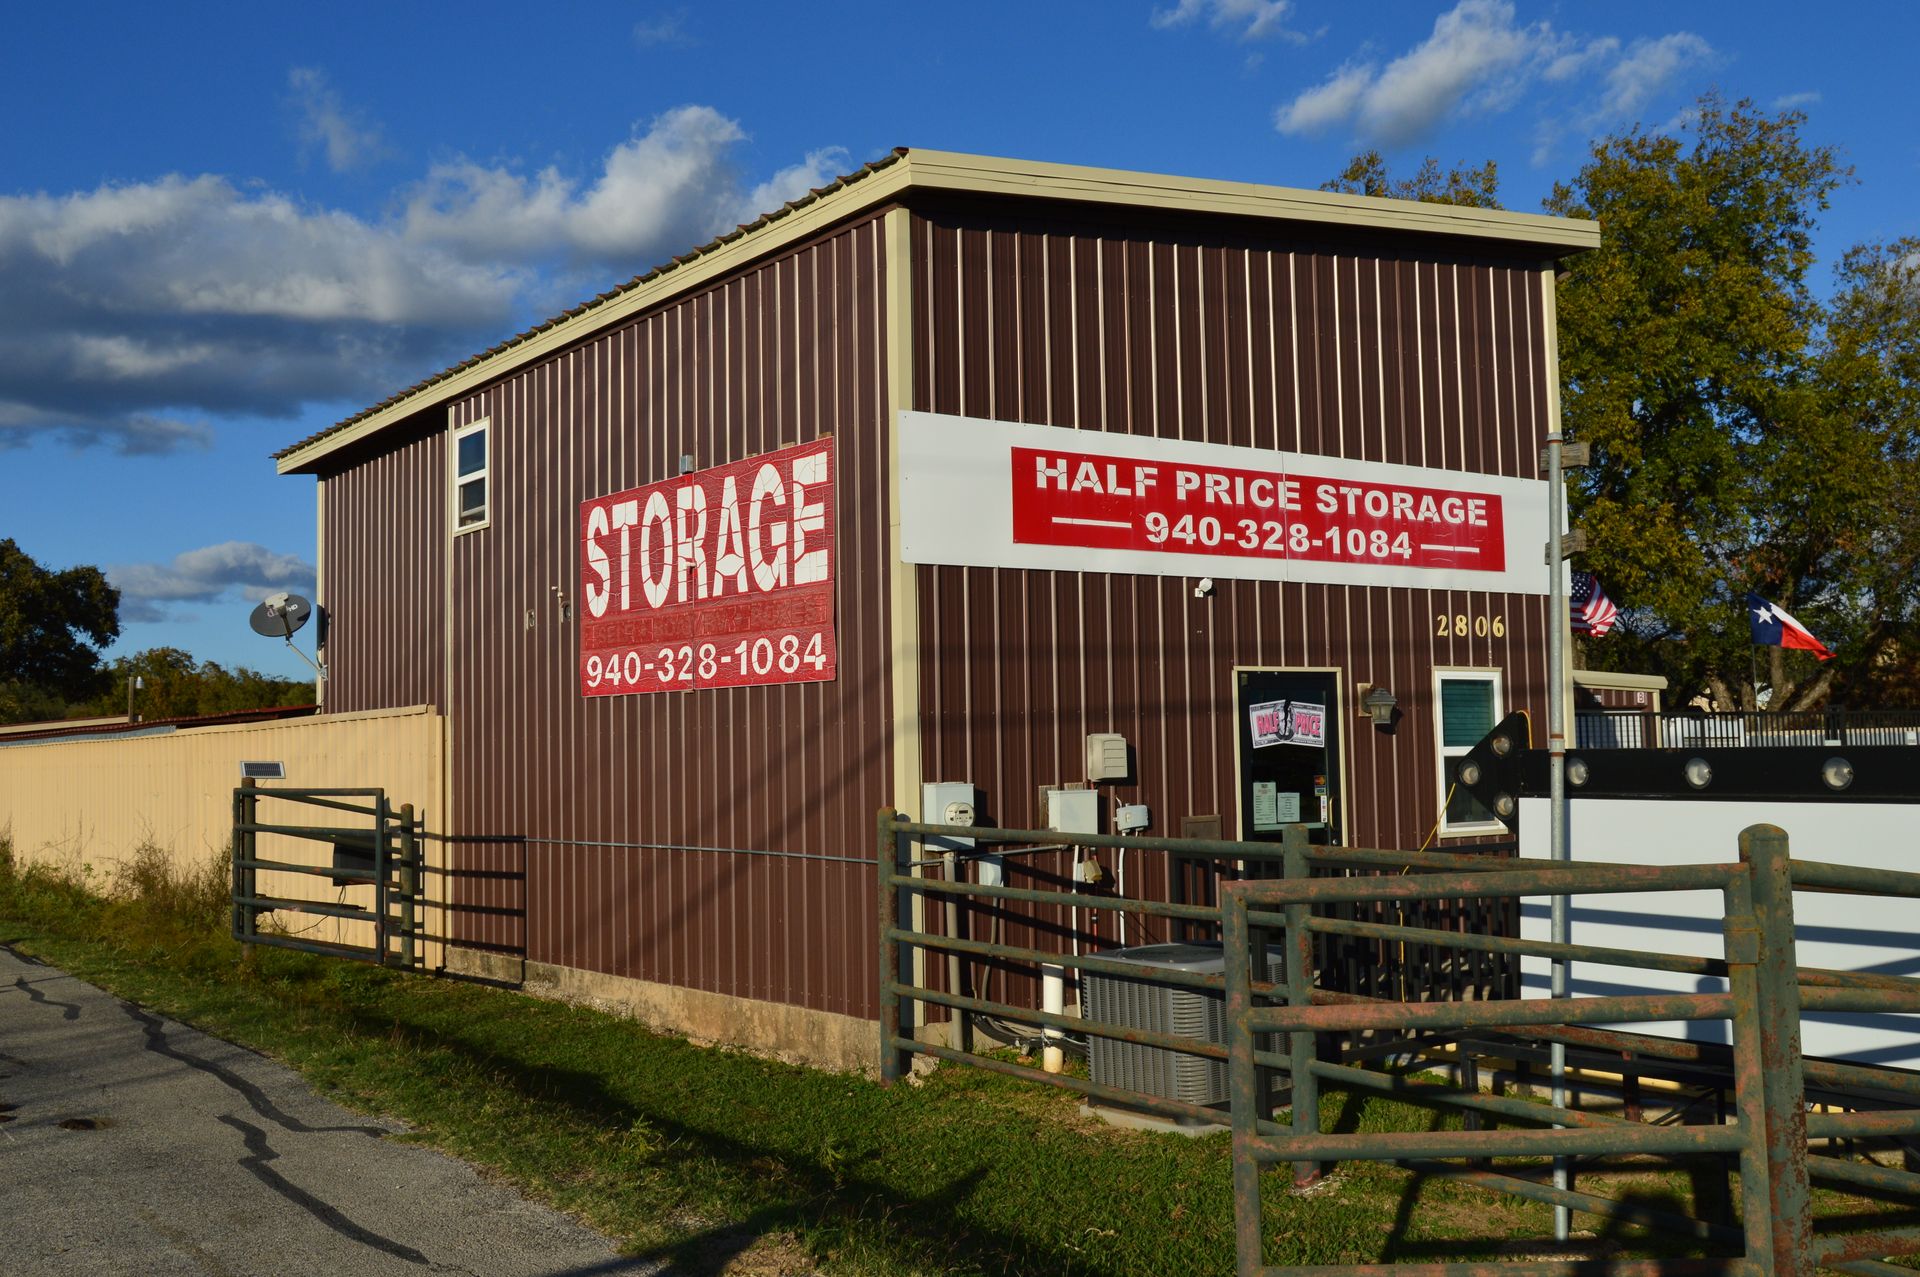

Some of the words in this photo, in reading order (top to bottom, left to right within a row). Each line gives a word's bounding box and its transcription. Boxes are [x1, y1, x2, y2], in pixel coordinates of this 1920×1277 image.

[1036, 457, 1158, 497] HALF
[1176, 470, 1302, 511] PRICE
[1316, 485, 1488, 527] STORAGE
[586, 452, 828, 618] STORAGE
[1145, 512, 1413, 559] 940-328-1084
[1437, 614, 1505, 638] 2806
[586, 633, 827, 687] 940-328-1084
[1256, 711, 1279, 736] HALF
[1296, 712, 1321, 737] PRICE
